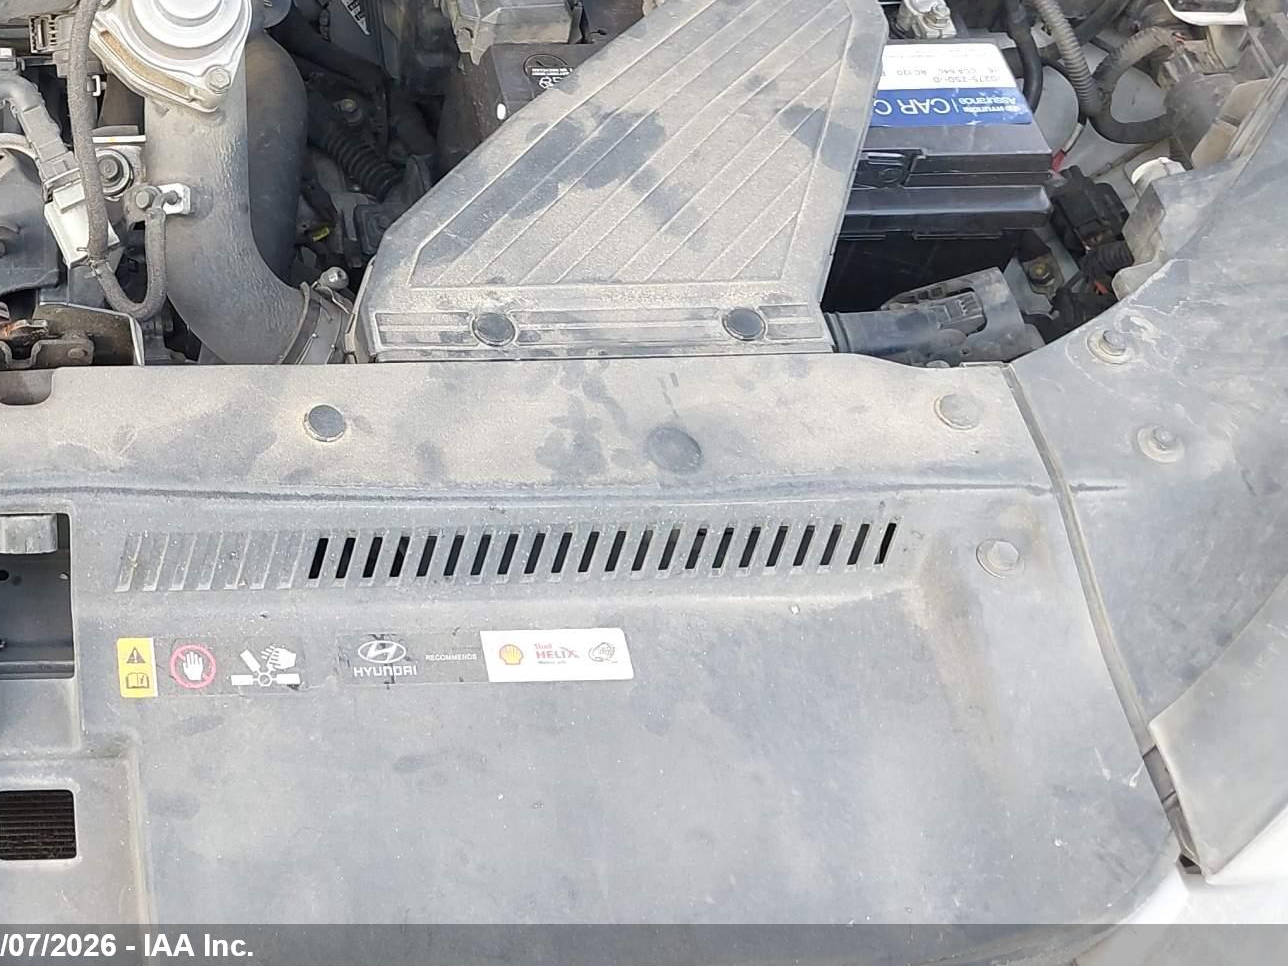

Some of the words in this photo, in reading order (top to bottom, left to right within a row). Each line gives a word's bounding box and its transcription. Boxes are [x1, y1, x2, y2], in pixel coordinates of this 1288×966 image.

[897, 97, 951, 115] CAR
[958, 96, 1017, 106] Assurance
[425, 653, 478, 661] RECOMMENDS
[535, 649, 580, 659] HELIX
[353, 665, 418, 677] HYUNDAI
